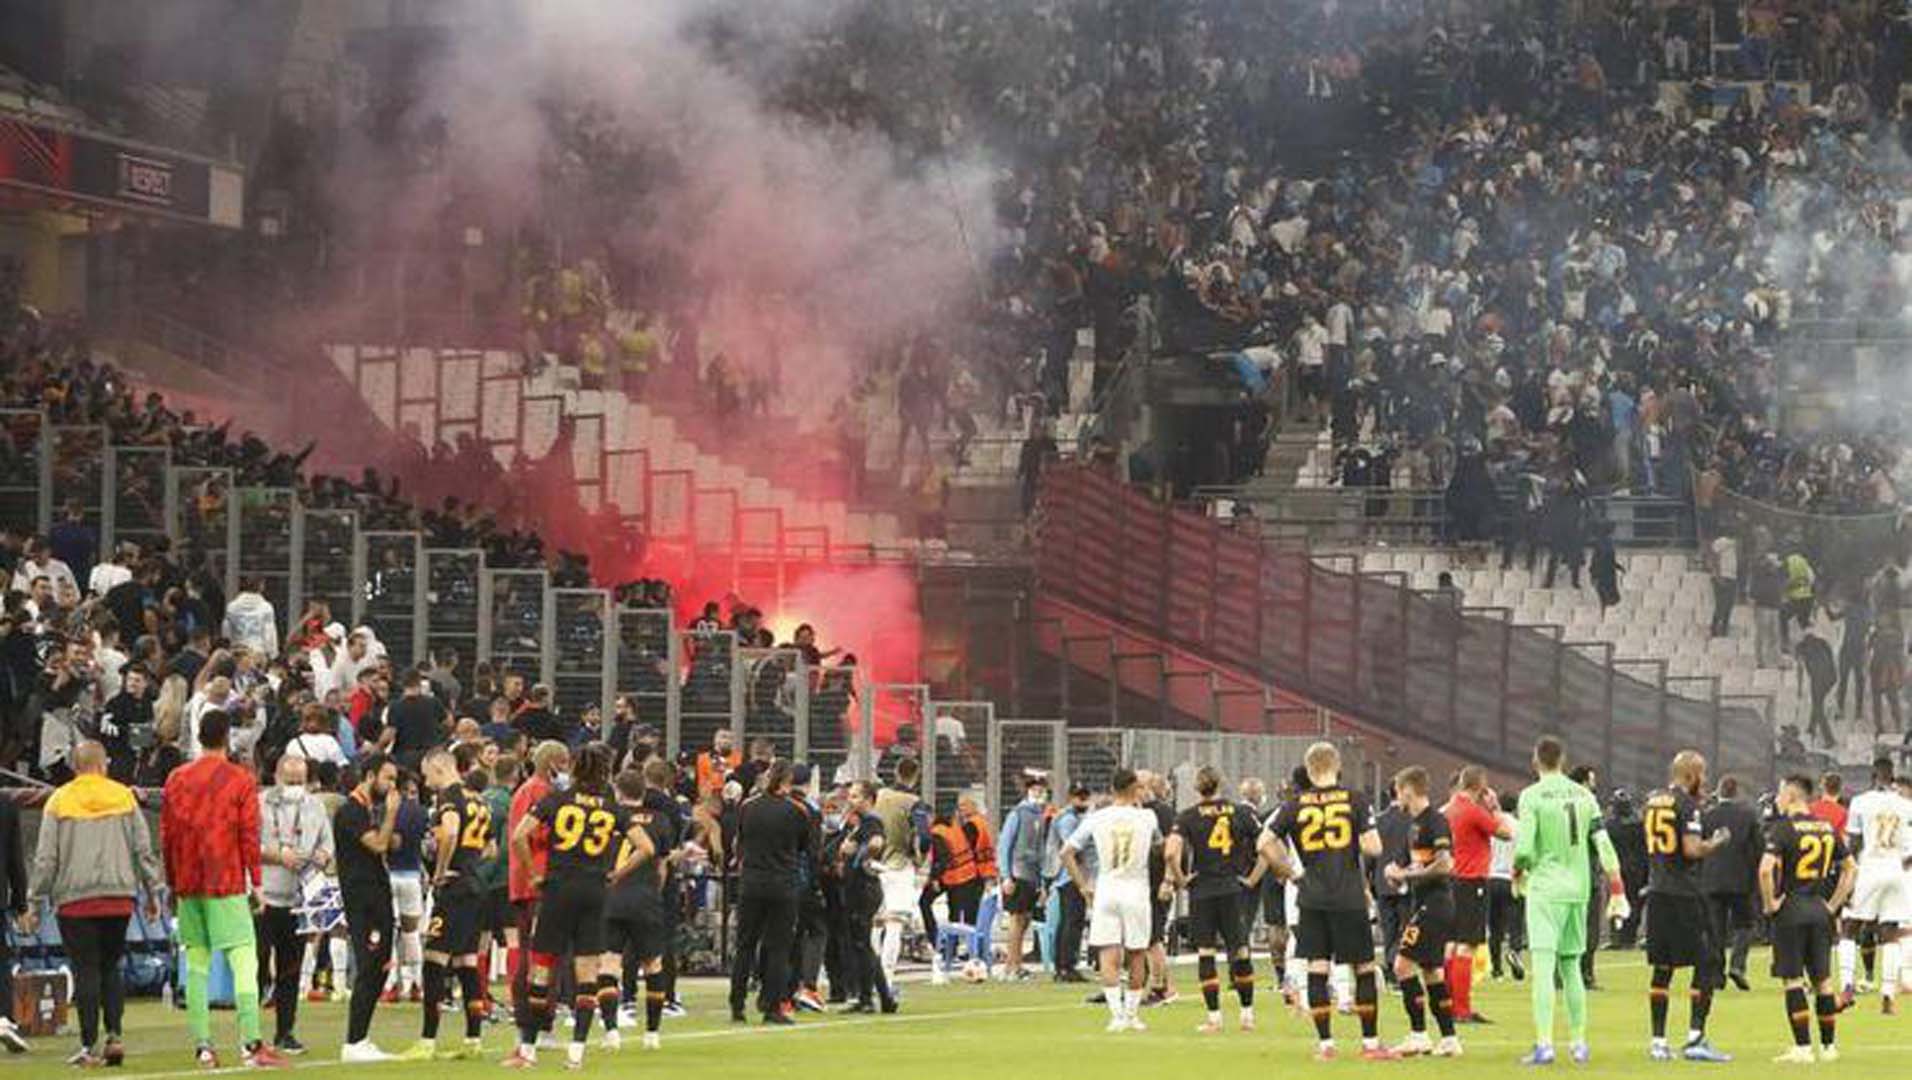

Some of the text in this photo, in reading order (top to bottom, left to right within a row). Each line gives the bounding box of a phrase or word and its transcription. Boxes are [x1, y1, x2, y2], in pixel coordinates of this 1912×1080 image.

[553, 804, 616, 856] 93
[1208, 815, 1232, 855] 4
[1297, 803, 1352, 851] 25
[1563, 802, 1579, 846] 1
[1645, 808, 1677, 854] 15
[1796, 834, 1834, 879] 21
